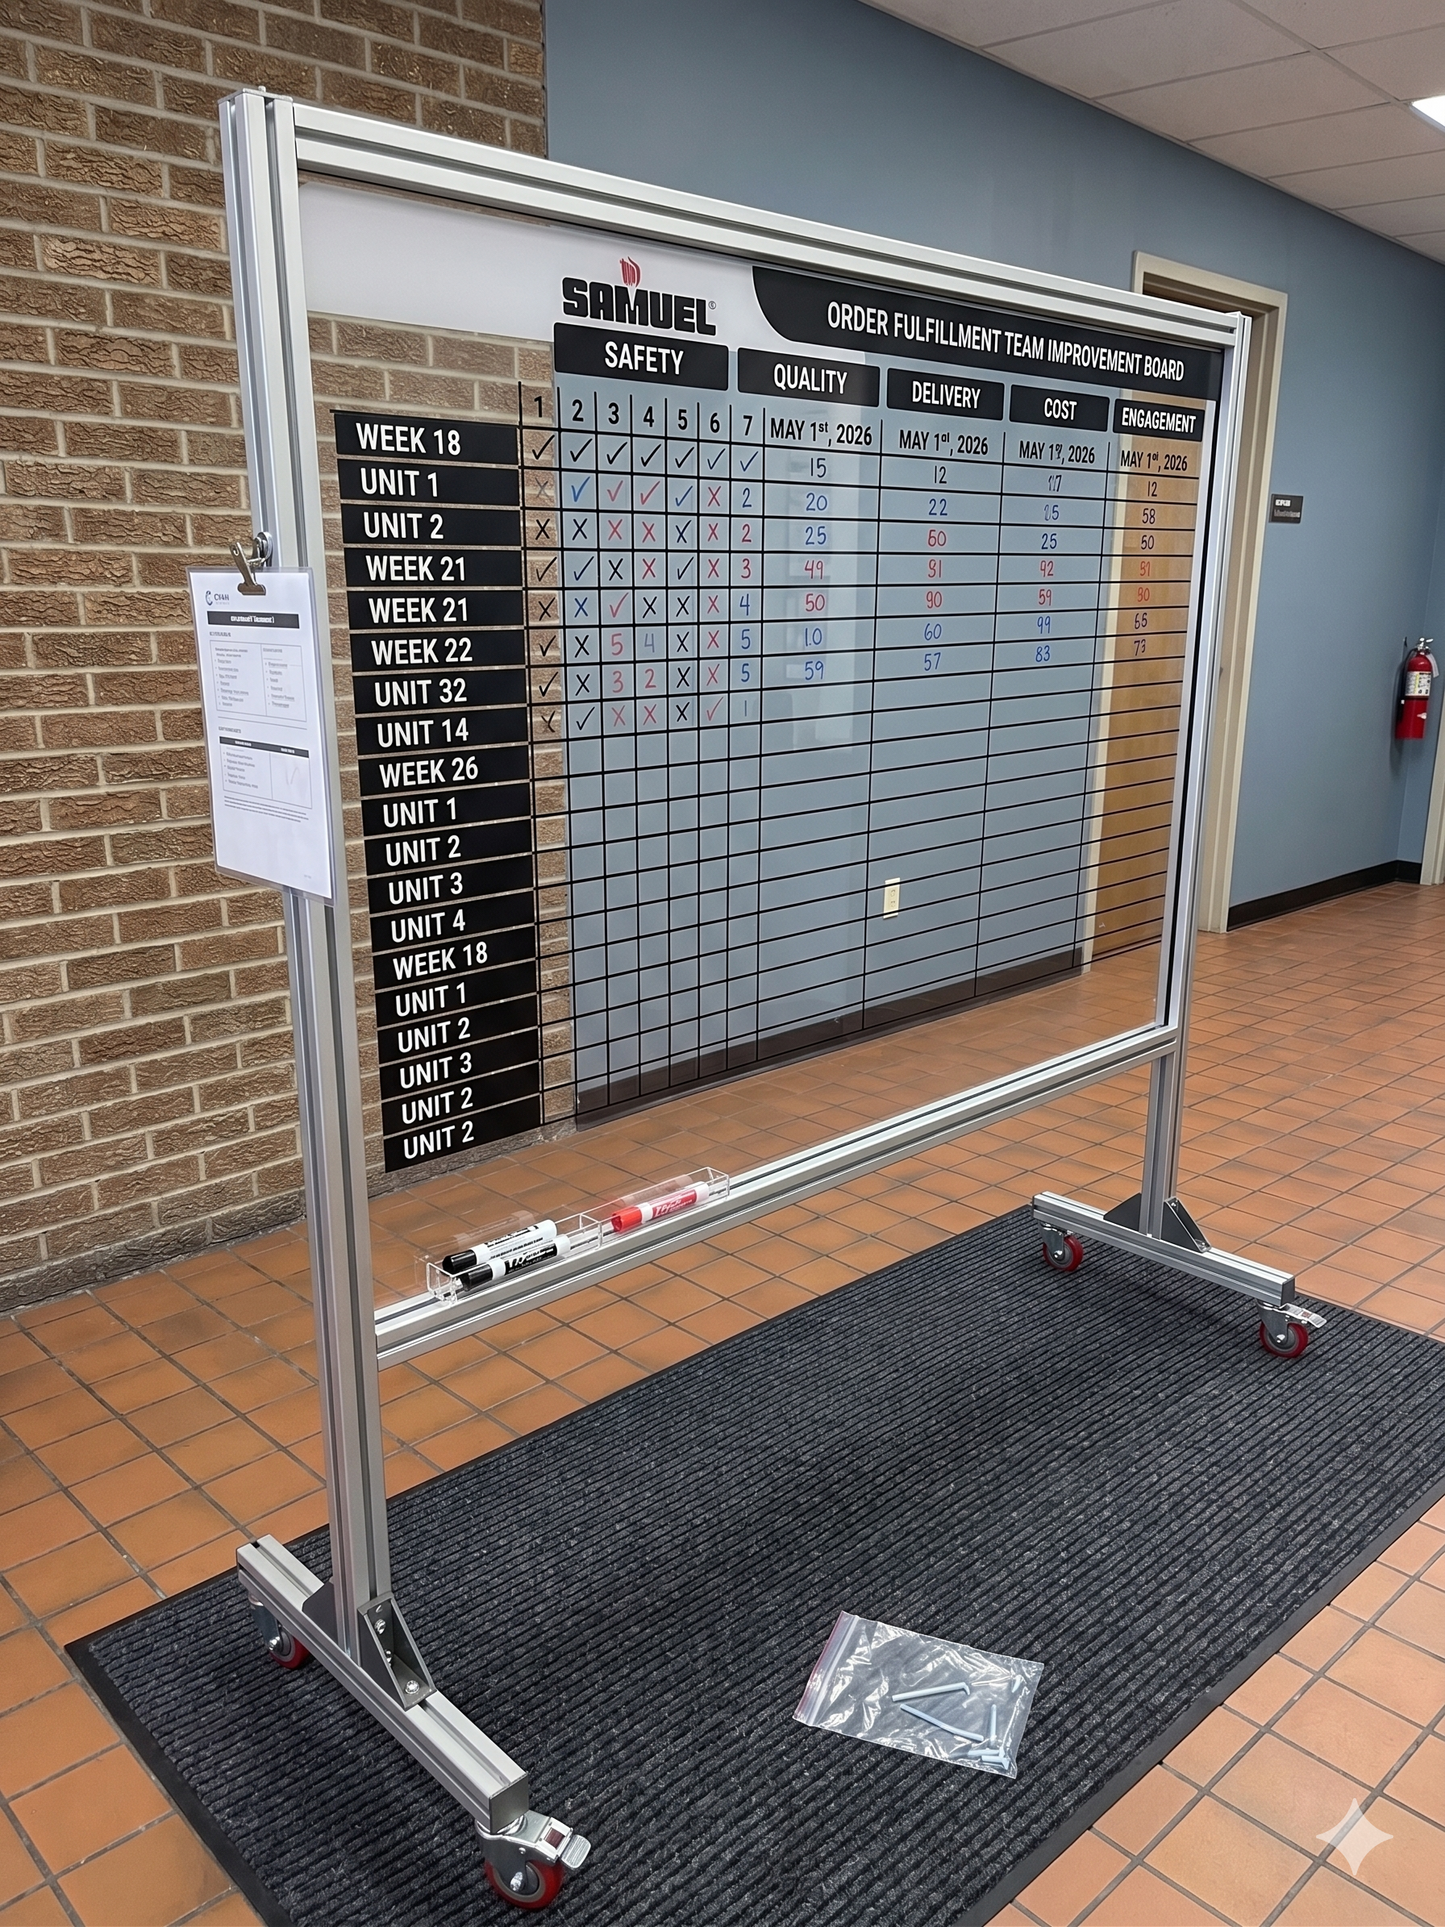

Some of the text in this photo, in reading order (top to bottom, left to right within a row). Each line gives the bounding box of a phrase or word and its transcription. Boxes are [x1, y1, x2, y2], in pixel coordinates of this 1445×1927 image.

[828, 302, 1184, 380] ORDER FULFILLMENT TEAM IMPROVEMENT BOARD
[605, 342, 683, 374] SAFETY
[774, 364, 847, 394] QUALITY
[913, 381, 980, 408] DELIVERY
[534, 396, 542, 417] 1
[572, 399, 584, 422] 2
[608, 402, 619, 424] 3
[643, 406, 654, 427] 4
[1045, 398, 1077, 420] COST
[678, 409, 687, 430] 5
[710, 413, 720, 433] 6
[743, 415, 753, 436] 7
[1122, 408, 1196, 432] ENGAGEMENT
[356, 423, 460, 455] WEEK 18
[771, 418, 805, 440] MAY
[837, 424, 872, 446] 2026
[900, 429, 929, 450] MAY
[957, 435, 988, 455] 2026
[1019, 440, 1045, 460] MAY
[1068, 445, 1095, 464] 2026
[1121, 450, 1143, 468] MAY
[1164, 454, 1187, 471] 2026
[811, 458, 826, 478] 15
[935, 466, 947, 484] 12
[361, 468, 437, 496] UNIT 1
[1148, 481, 1157, 497] 12
[742, 488, 752, 508] 2
[806, 493, 827, 511] 20
[929, 498, 948, 516] 22
[364, 512, 443, 538] UNIT 2
[742, 524, 751, 543] 2
[805, 526, 826, 545] 25
[1041, 533, 1057, 550] 25
[366, 556, 464, 580] WEEK 21
[741, 558, 751, 579] 3
[805, 560, 823, 579] 49
[1040, 560, 1053, 577] 92
[740, 594, 750, 616] 4
[806, 593, 825, 612] 50
[1039, 589, 1051, 606] 59
[369, 598, 467, 623] WEEK 21
[924, 623, 942, 641] 60
[1037, 616, 1050, 634] 99
[612, 633, 623, 655] 5
[741, 629, 750, 649] 5
[371, 638, 472, 665] WEEK 22
[924, 652, 941, 671] 57
[1036, 645, 1050, 662] 83
[645, 669, 656, 688] 2
[741, 663, 750, 682] 5
[805, 661, 823, 680] 59
[375, 678, 466, 706] UNIT 32
[613, 671, 623, 693] 3
[378, 718, 468, 747] UNIT 14
[379, 756, 478, 788] WEEK 26
[384, 797, 455, 827] UNIT 1
[386, 835, 461, 867] UNIT 2
[388, 872, 462, 905] UNIT 3
[391, 909, 465, 943] UNIT 4
[393, 942, 487, 981] WEEK 18
[395, 983, 465, 1017] UNIT 1
[397, 1017, 470, 1054] UNIT 2
[399, 1052, 471, 1089] UNIT 3
[401, 1087, 473, 1125] UNIT 2
[403, 1121, 474, 1159] UNIT 2
